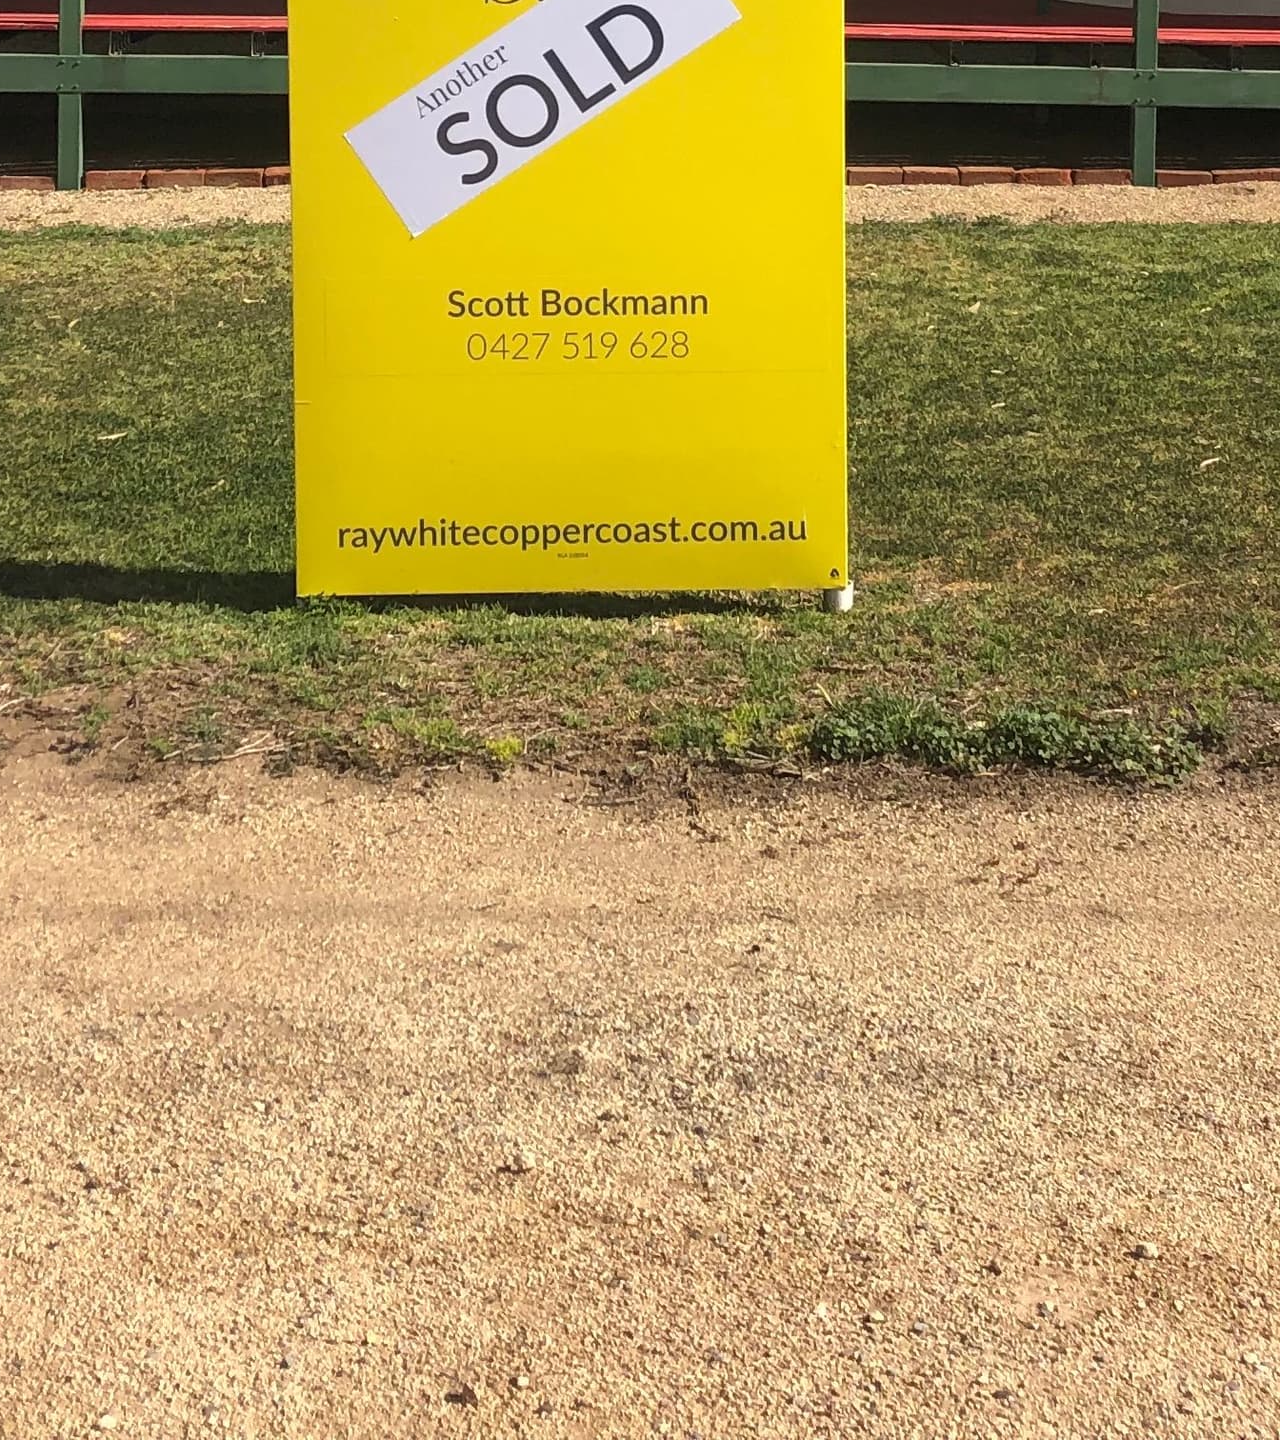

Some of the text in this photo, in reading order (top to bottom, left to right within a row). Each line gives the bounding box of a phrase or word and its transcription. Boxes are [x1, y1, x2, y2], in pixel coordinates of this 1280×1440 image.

[415, 45, 509, 120] Another
[435, 3, 665, 186] SOLD
[448, 288, 708, 318] Scott Bockmann
[467, 331, 689, 361] 0427 519 628
[338, 517, 807, 555] raywhitecoppercoast.com.au
